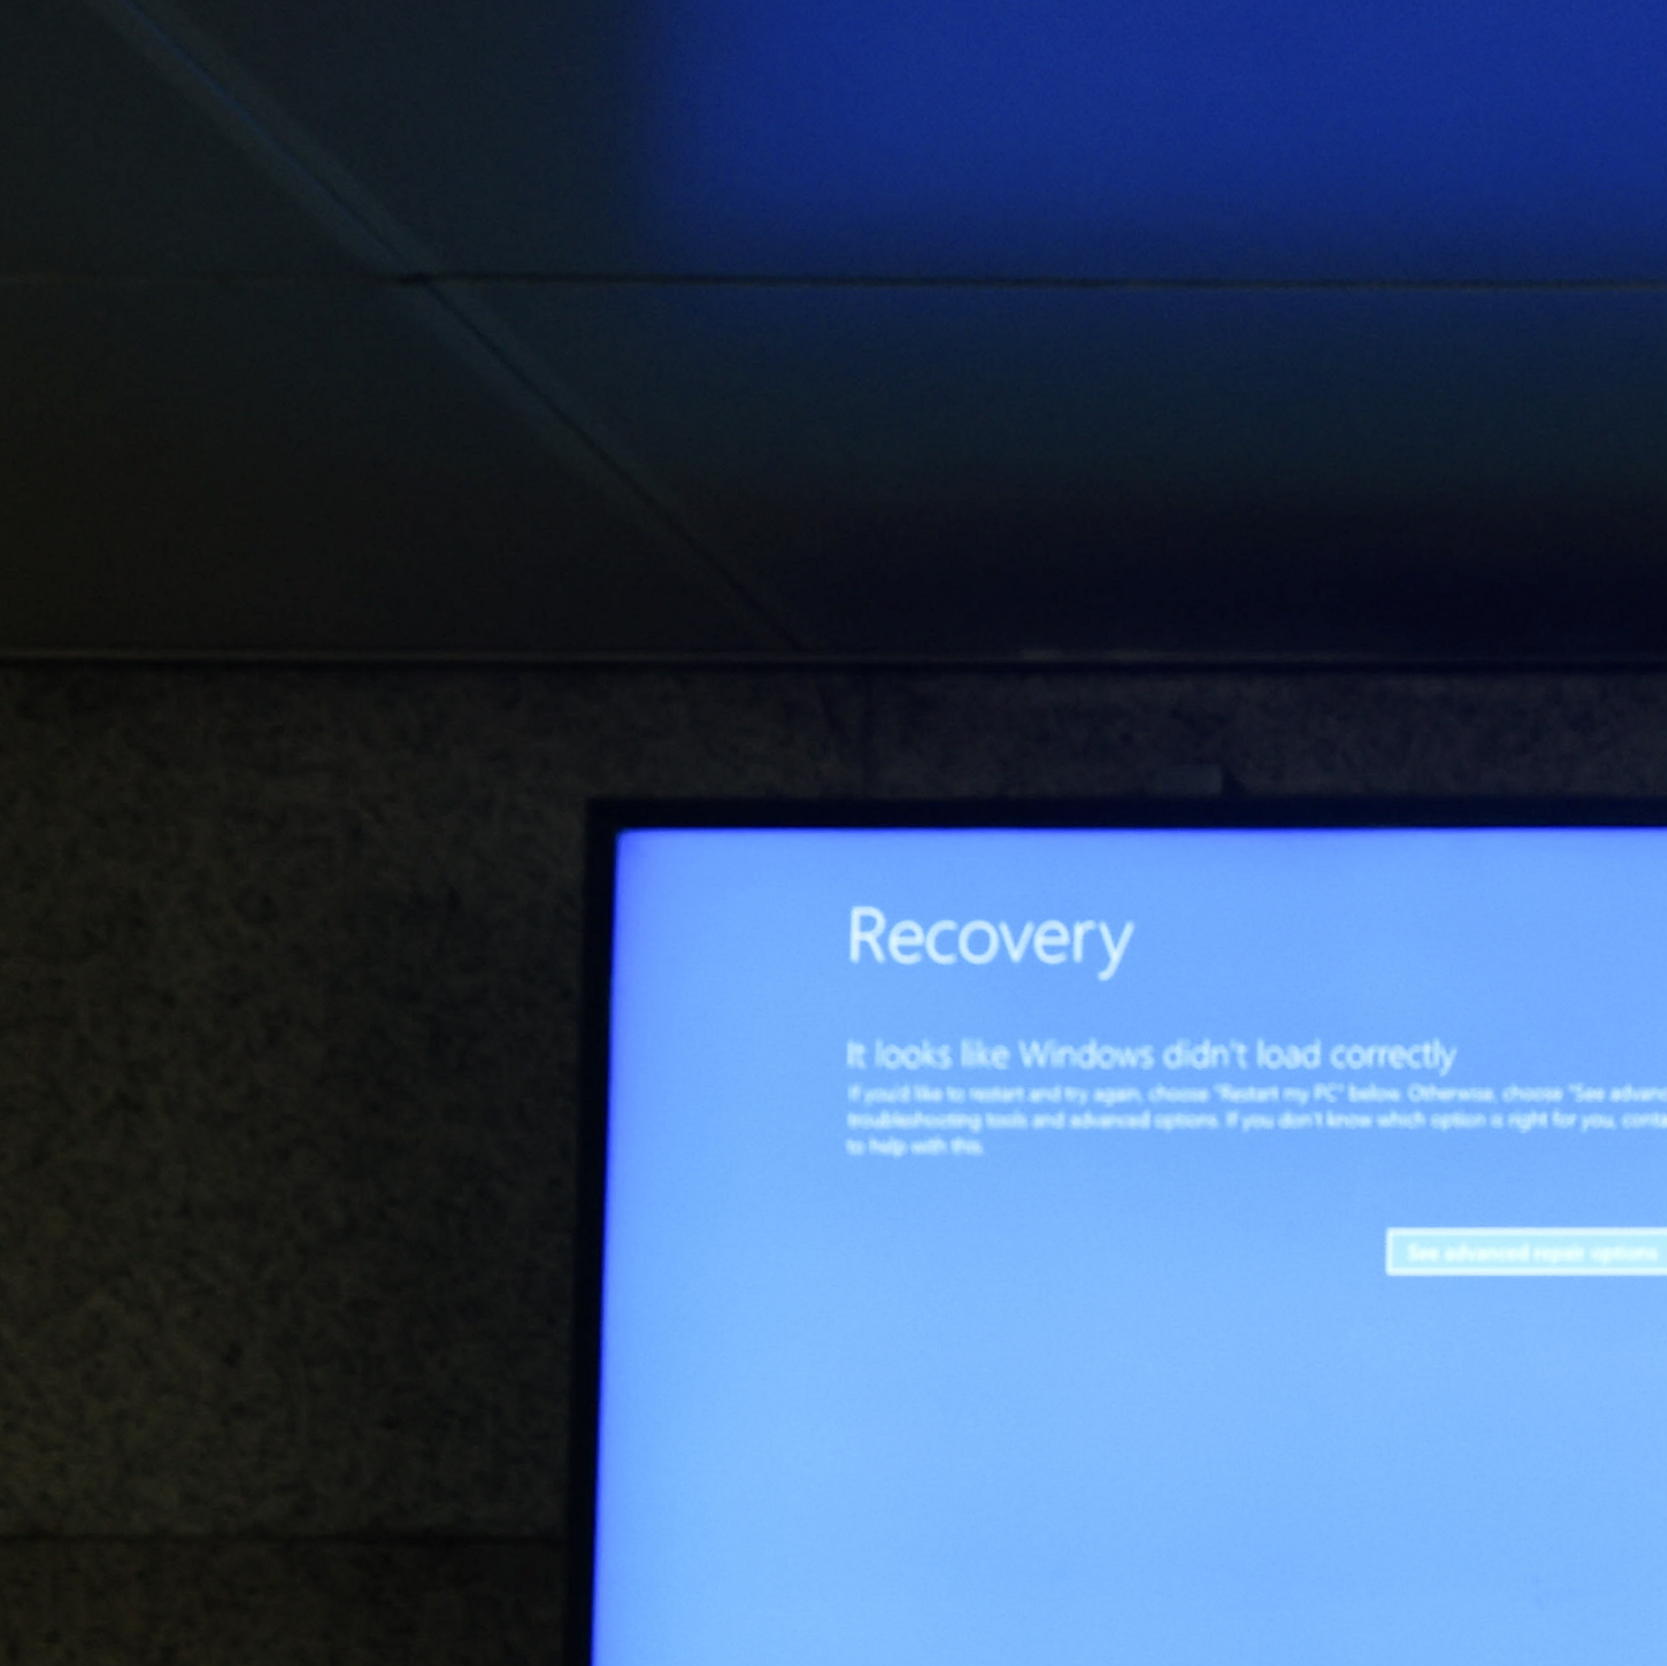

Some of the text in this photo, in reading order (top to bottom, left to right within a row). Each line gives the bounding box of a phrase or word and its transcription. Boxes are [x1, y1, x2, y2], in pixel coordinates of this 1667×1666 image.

[848, 904, 1136, 982] Recovery
[846, 1038, 1458, 1077] It looks like Windows didn't load correctly
